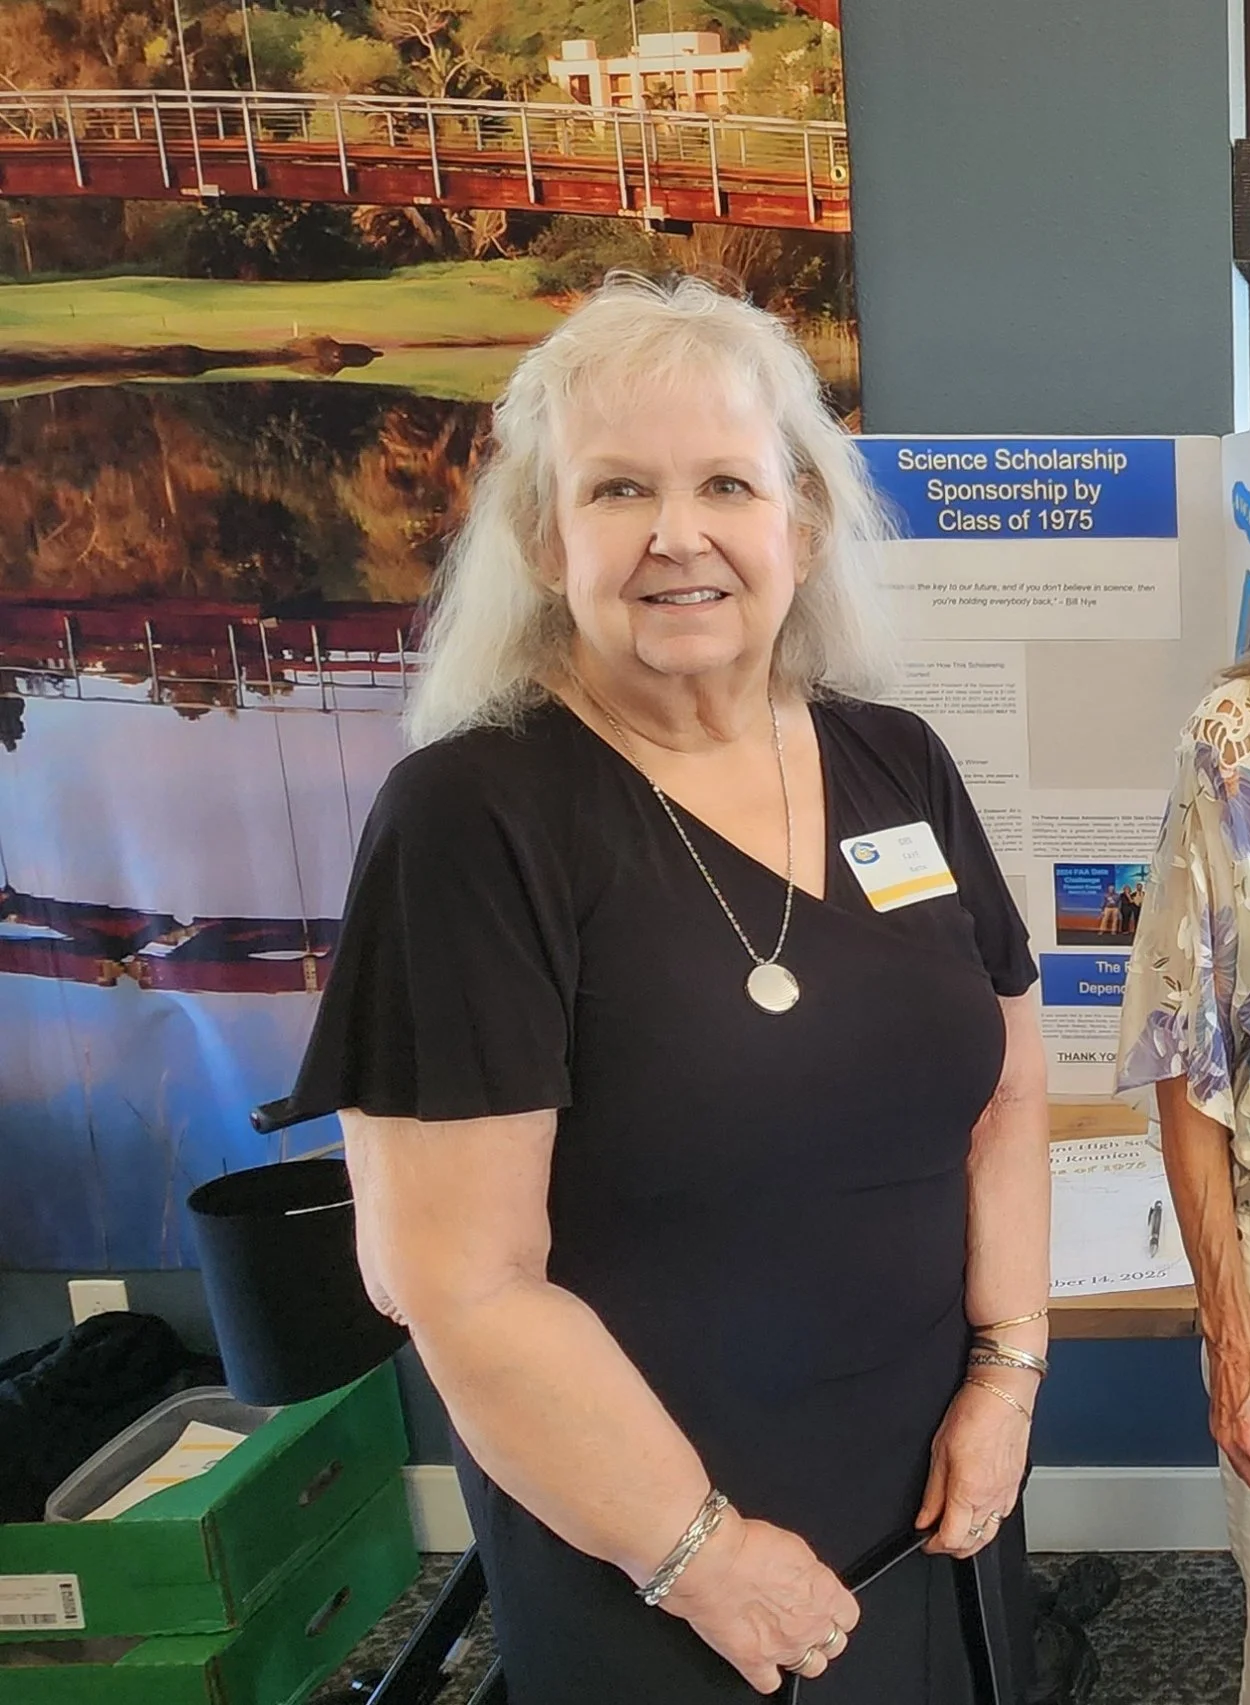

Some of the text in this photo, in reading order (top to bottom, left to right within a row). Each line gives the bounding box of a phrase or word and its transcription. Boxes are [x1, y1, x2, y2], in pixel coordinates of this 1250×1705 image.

[898, 448, 1127, 474] Science Scholarship
[927, 478, 1102, 505] Sponsorship by
[938, 509, 1093, 531] Class of 1975
[917, 583, 931, 591] the
[932, 582, 947, 593] key
[949, 583, 958, 591] to
[959, 583, 973, 591] our
[1002, 583, 1018, 591] and
[1026, 584, 1040, 593] you
[1063, 583, 1092, 592] believe
[1138, 584, 1156, 592] then
[958, 597, 988, 607] holding
[989, 598, 1031, 607] everybody
[1065, 598, 1079, 606] Bill
[1081, 598, 1097, 608] Nye
[1095, 960, 1121, 973] The
[1057, 1052, 1096, 1061] THANK
[1079, 1141, 1119, 1150] High
[1067, 1151, 1140, 1163] Reunion
[1049, 1279, 1086, 1288] ber
[1119, 1269, 1168, 1281] 2025
